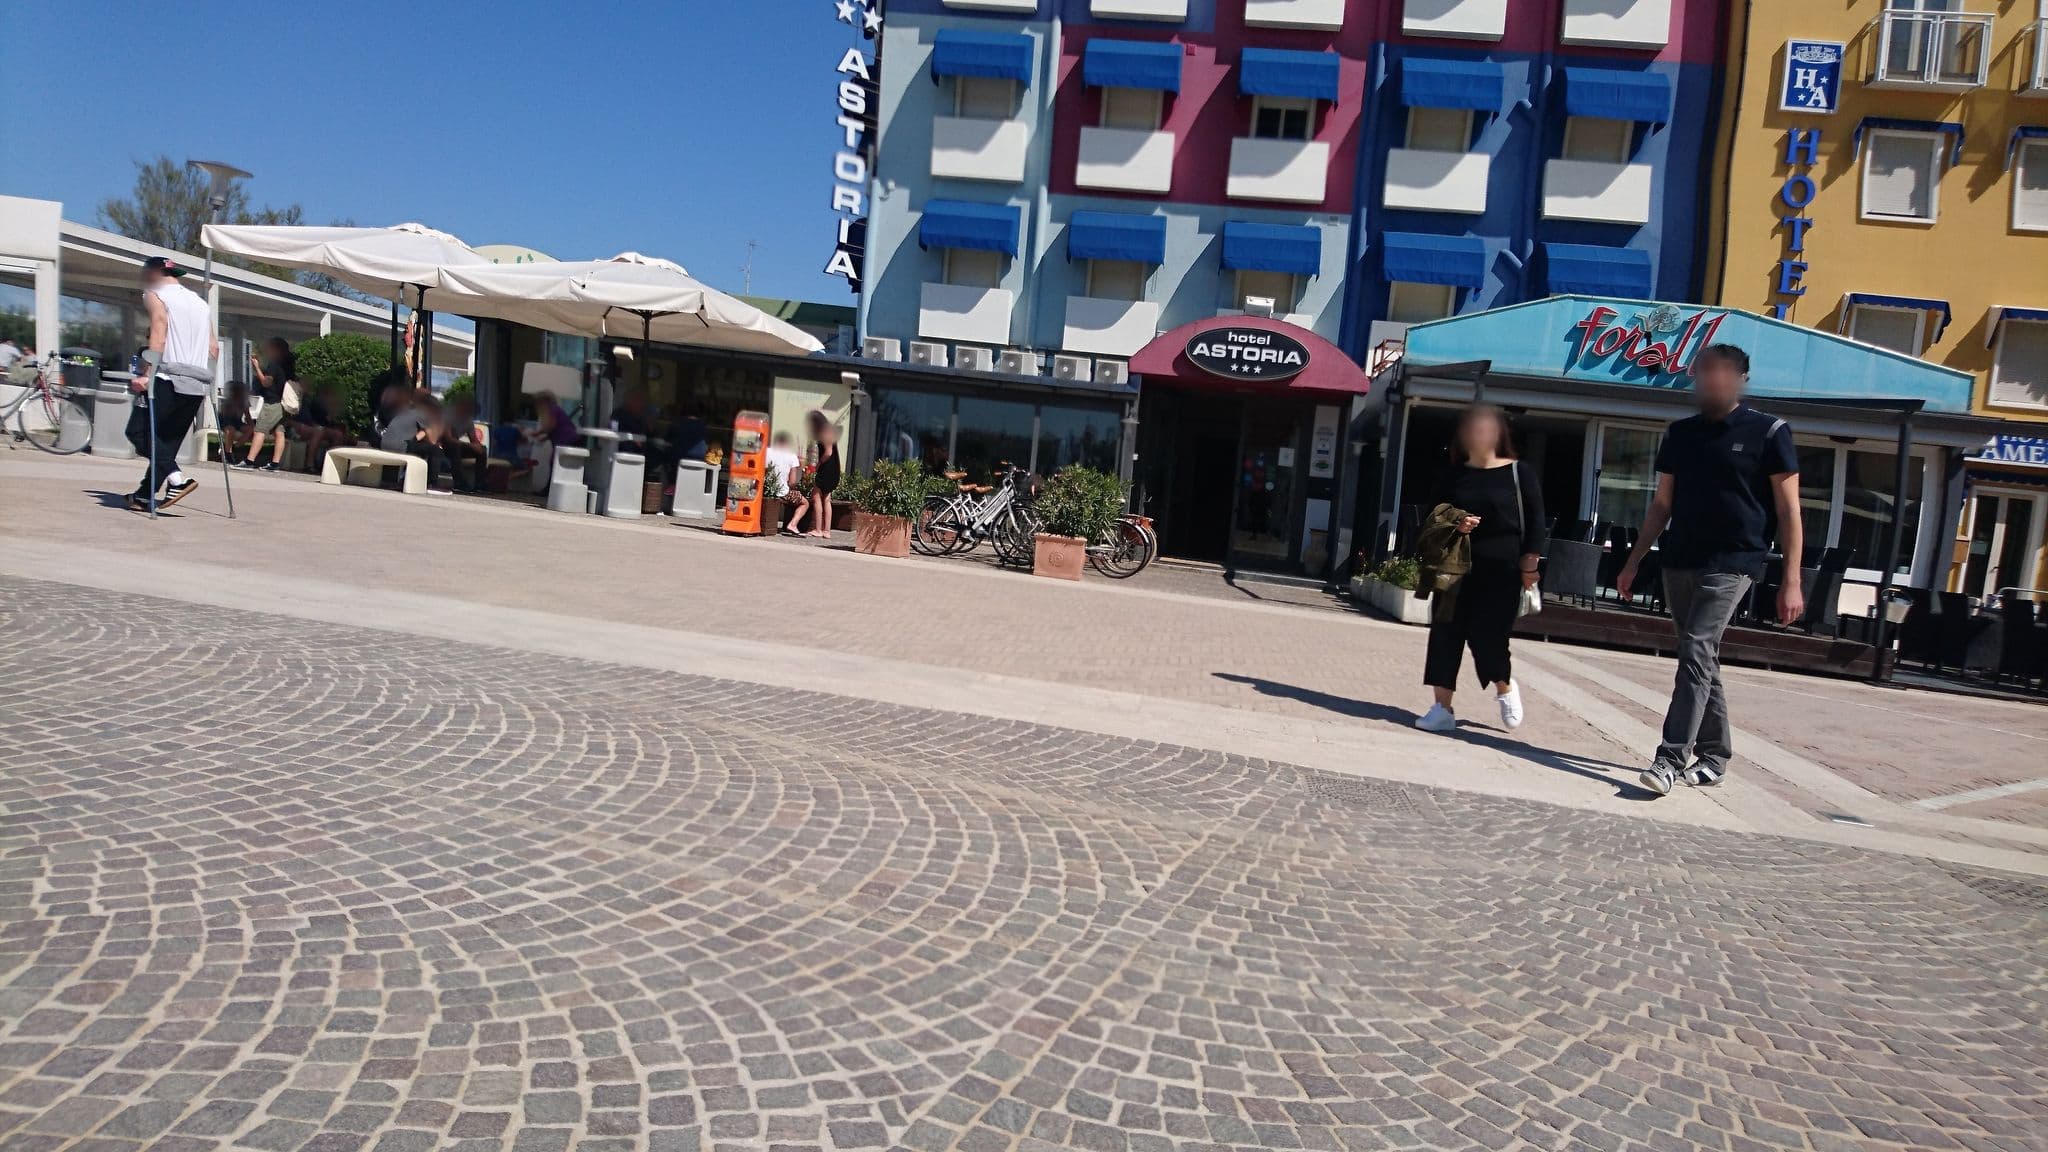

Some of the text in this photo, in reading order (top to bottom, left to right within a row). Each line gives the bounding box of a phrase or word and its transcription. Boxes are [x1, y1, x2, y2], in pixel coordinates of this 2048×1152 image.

[824, 48, 870, 279] ASTORIA
[1227, 331, 1271, 345] hotel
[1192, 342, 1302, 366] ASTORIA
[1980, 442, 2048, 464] AME
